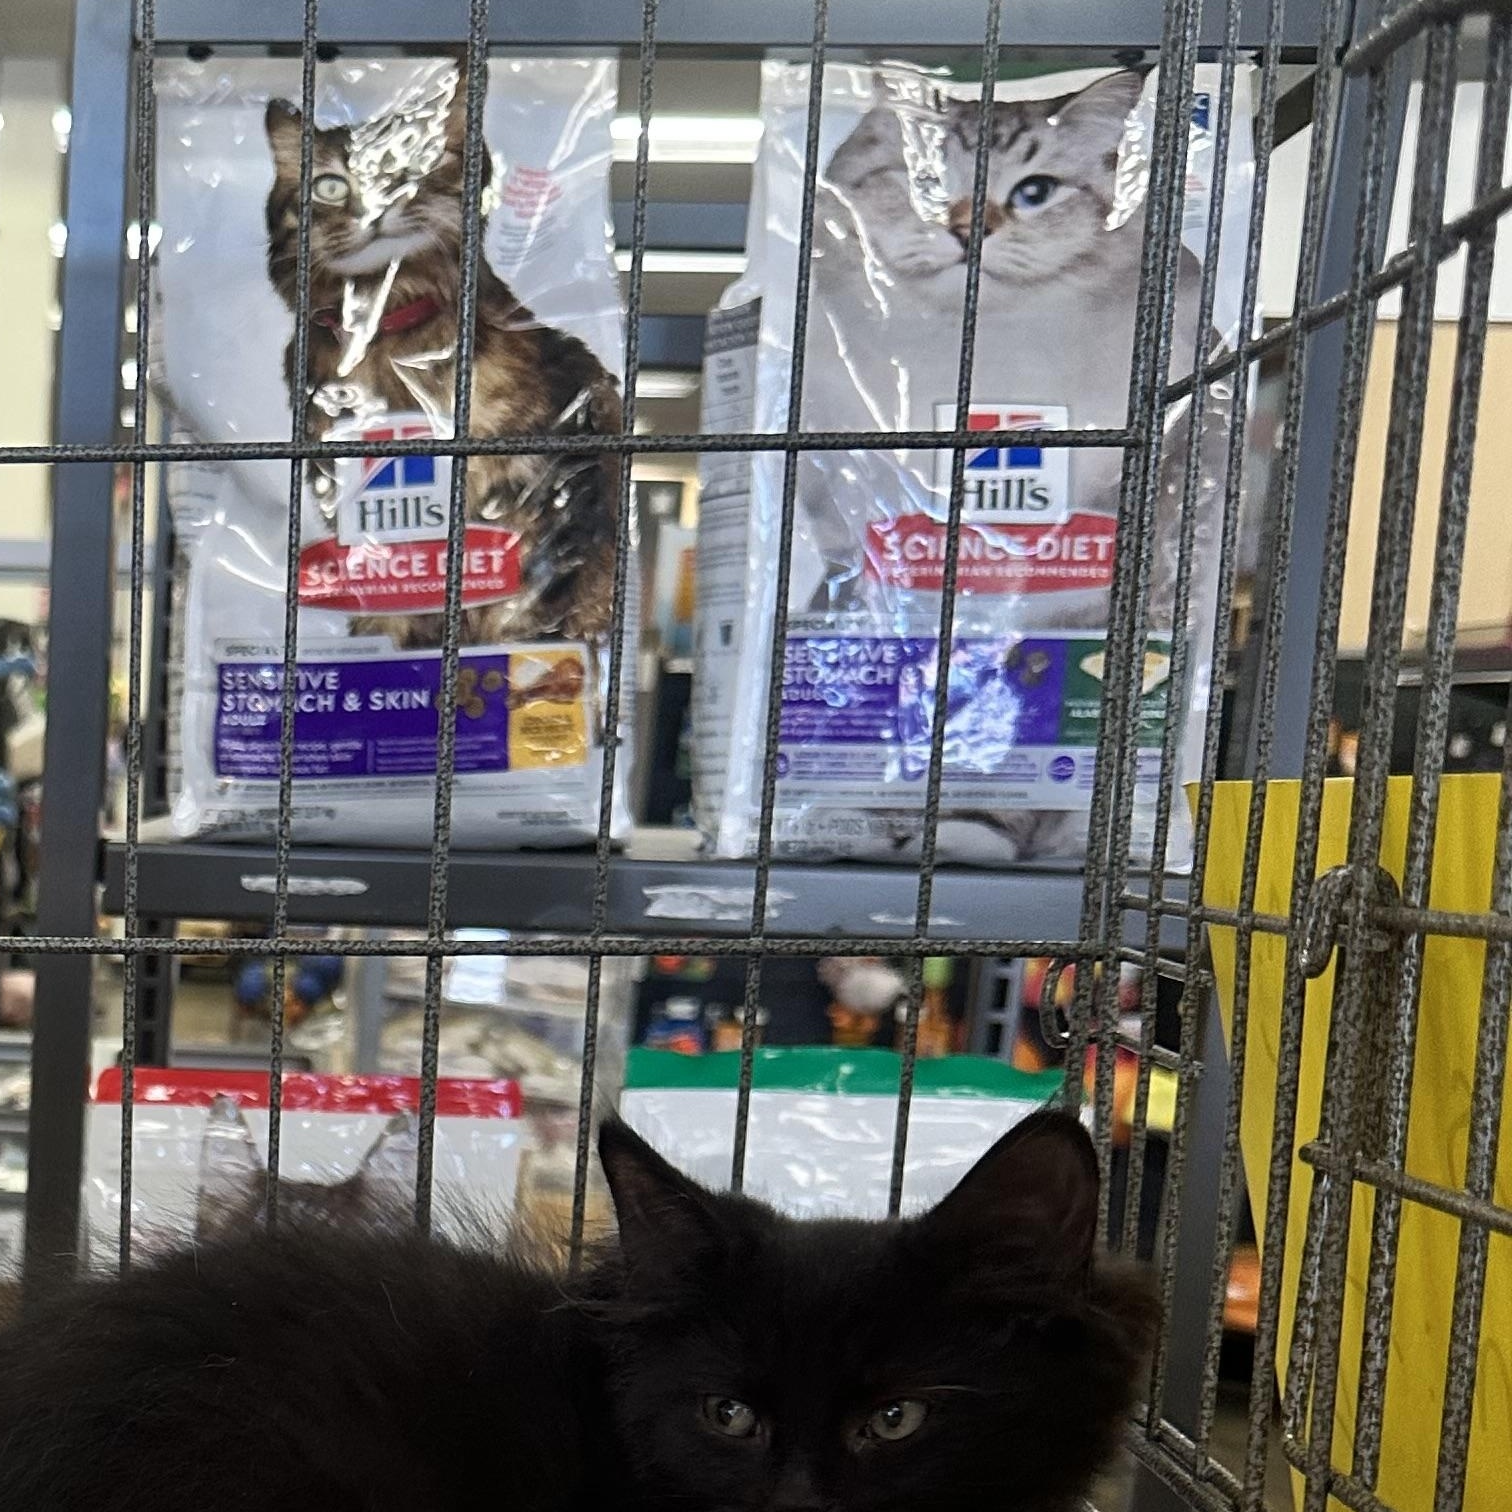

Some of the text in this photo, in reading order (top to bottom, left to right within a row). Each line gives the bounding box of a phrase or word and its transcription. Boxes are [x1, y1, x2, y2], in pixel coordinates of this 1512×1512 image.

[357, 495, 445, 532] Hill's
[1037, 532, 1114, 561] DIET
[305, 551, 429, 586] SCIENCE
[221, 671, 340, 691] SENSIIVE
[343, 690, 363, 712] &
[368, 689, 431, 711] SKIN
